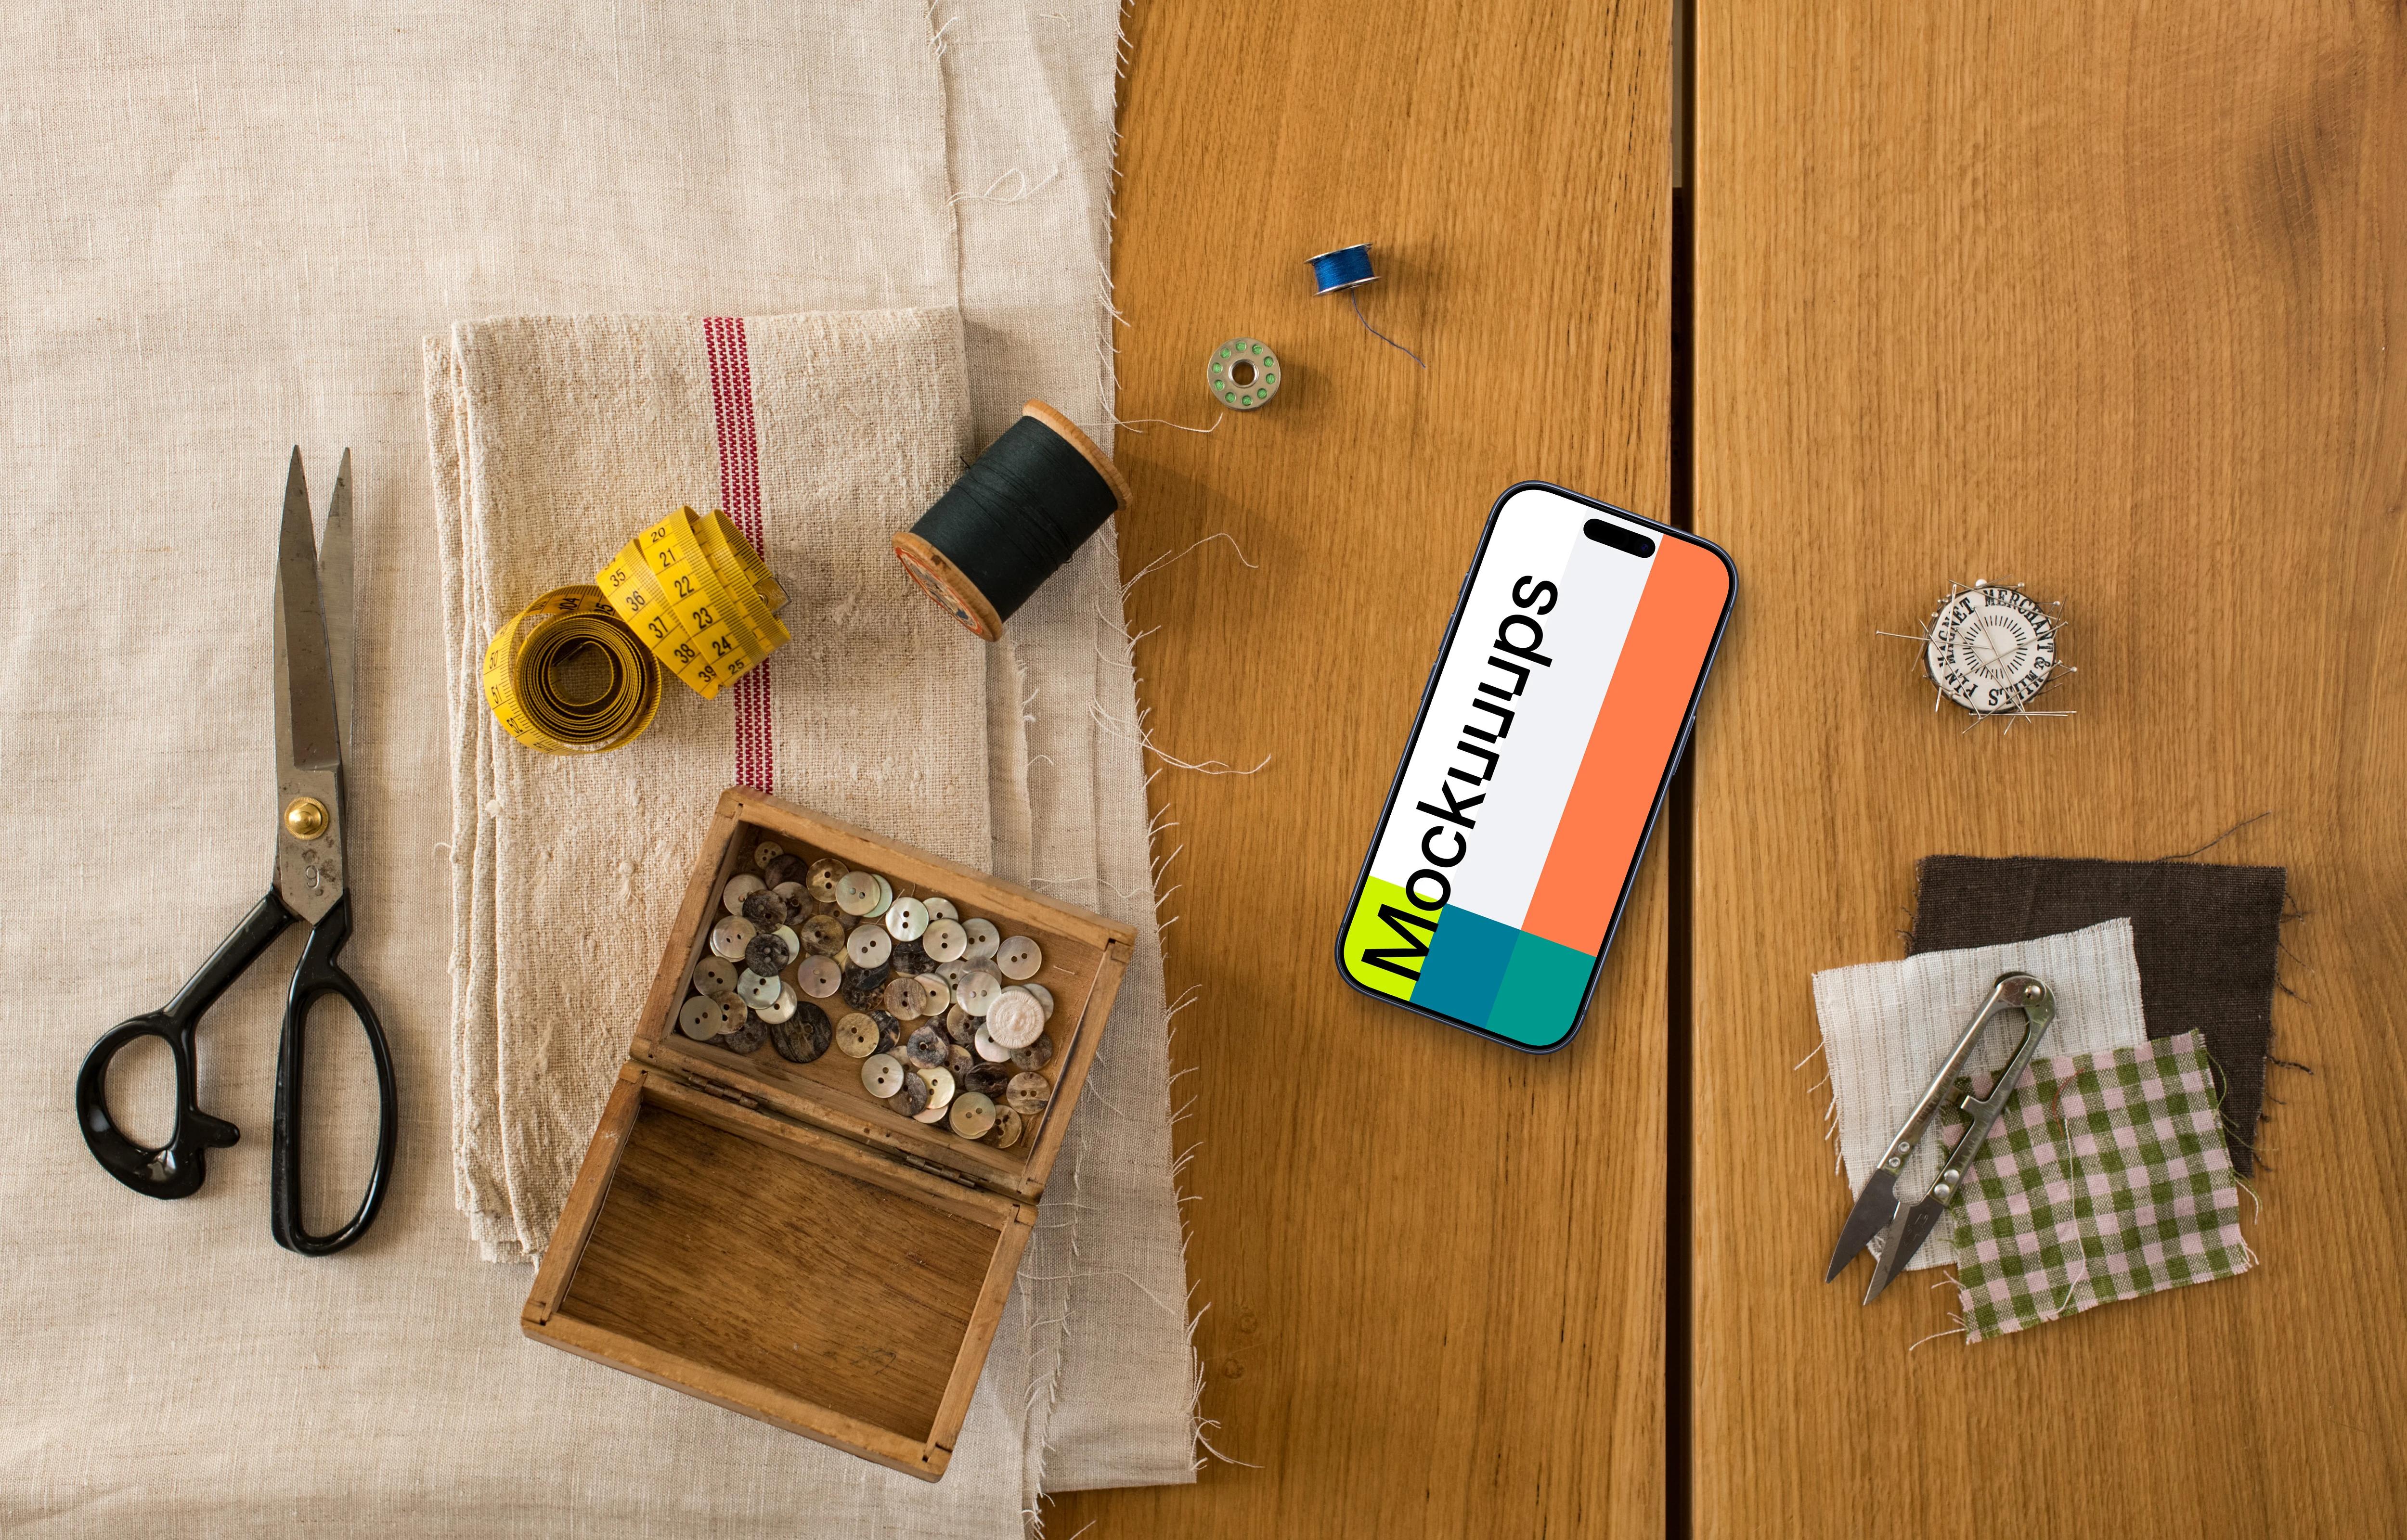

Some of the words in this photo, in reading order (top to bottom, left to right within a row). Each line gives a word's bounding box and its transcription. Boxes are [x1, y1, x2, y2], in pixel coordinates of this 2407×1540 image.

[651, 527, 665, 542] 20
[660, 548, 676, 567] 21
[610, 568, 625, 587] 35
[674, 576, 694, 598] 22
[558, 598, 580, 610] 104
[626, 590, 645, 611] 36
[648, 616, 668, 638] 37
[693, 607, 713, 629] 23
[1983, 590, 2054, 653] MERCHANT
[1937, 597, 1975, 667] MAGNET
[674, 644, 695, 664] 38
[712, 636, 732, 656] 24
[489, 650, 498, 669] 50
[728, 659, 744, 675] 25
[2033, 656, 2051, 670] &
[699, 666, 717, 682] 39
[1944, 668, 1978, 698] PIN
[491, 684, 502, 704] 51
[1989, 670, 2044, 706] MILLS
[506, 718, 523, 734] 52
[1361, 575, 1558, 982] Mockuuups
[305, 865, 319, 889] 9
